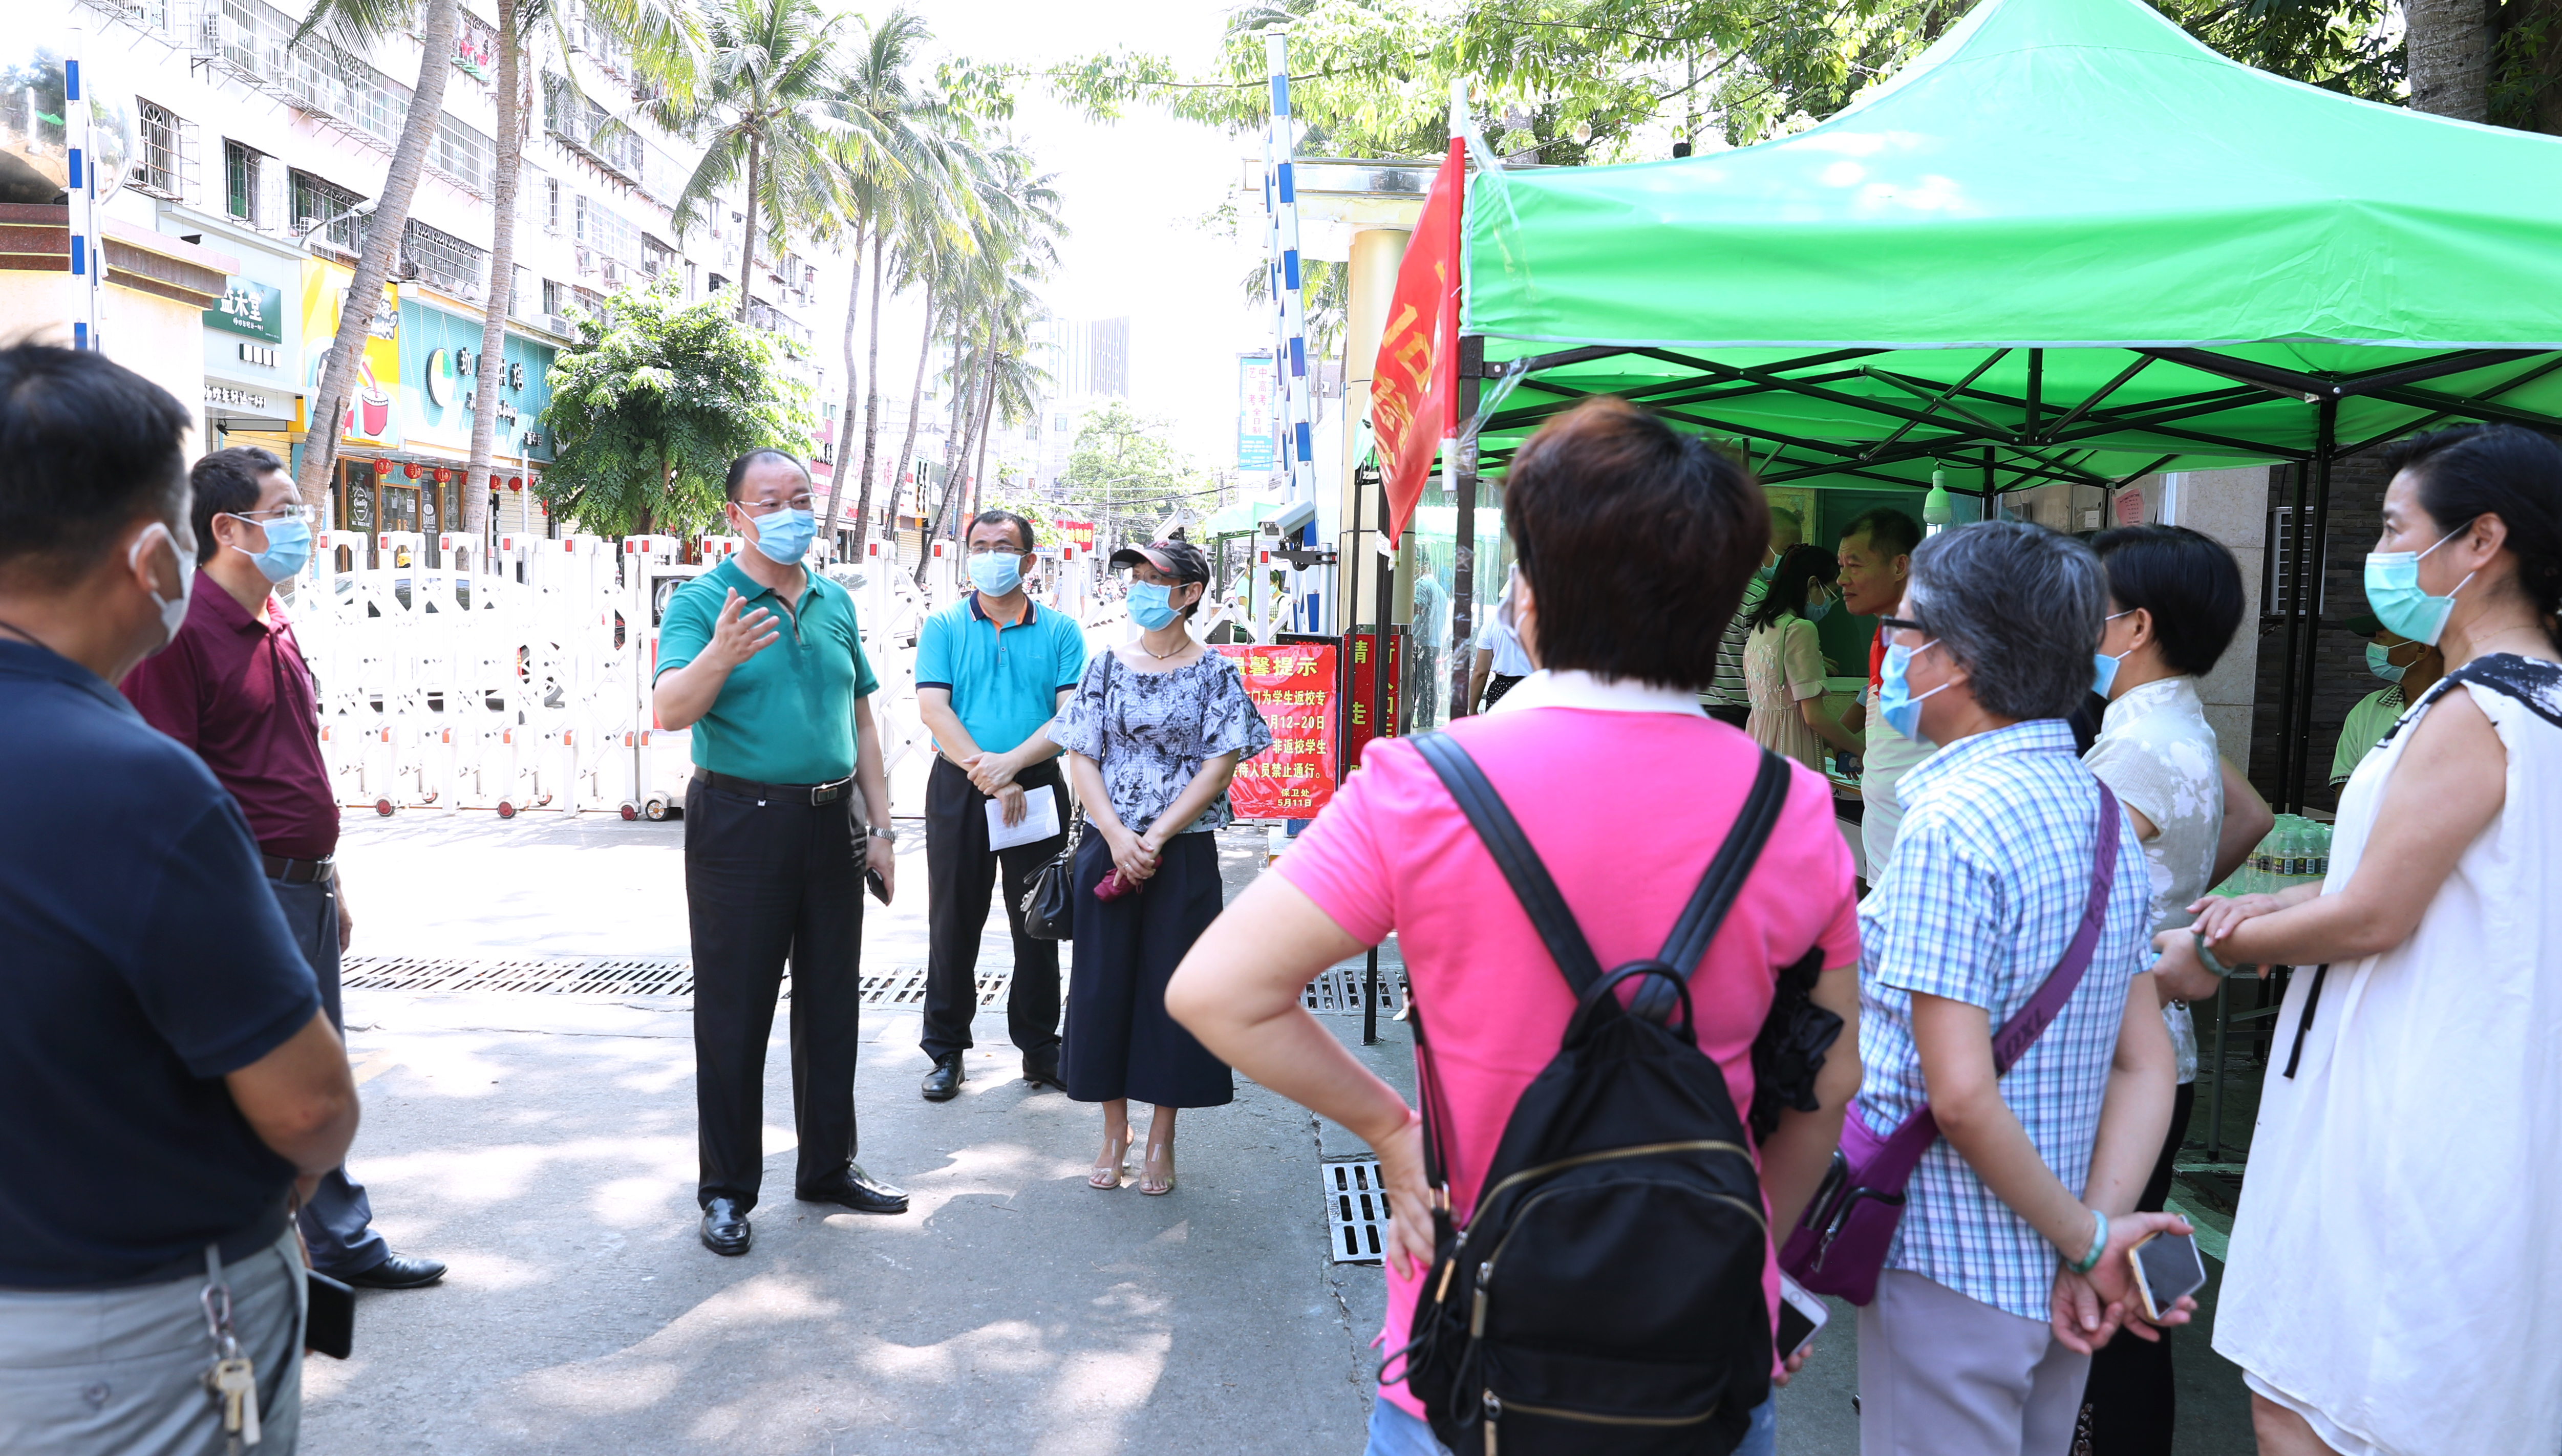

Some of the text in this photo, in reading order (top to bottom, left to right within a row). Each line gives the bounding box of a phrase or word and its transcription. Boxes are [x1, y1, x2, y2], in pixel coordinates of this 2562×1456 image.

[220, 284, 263, 322] 益禾堂
[1280, 788, 1310, 797] 保卫处
[1277, 798, 1312, 807] 5月11日
